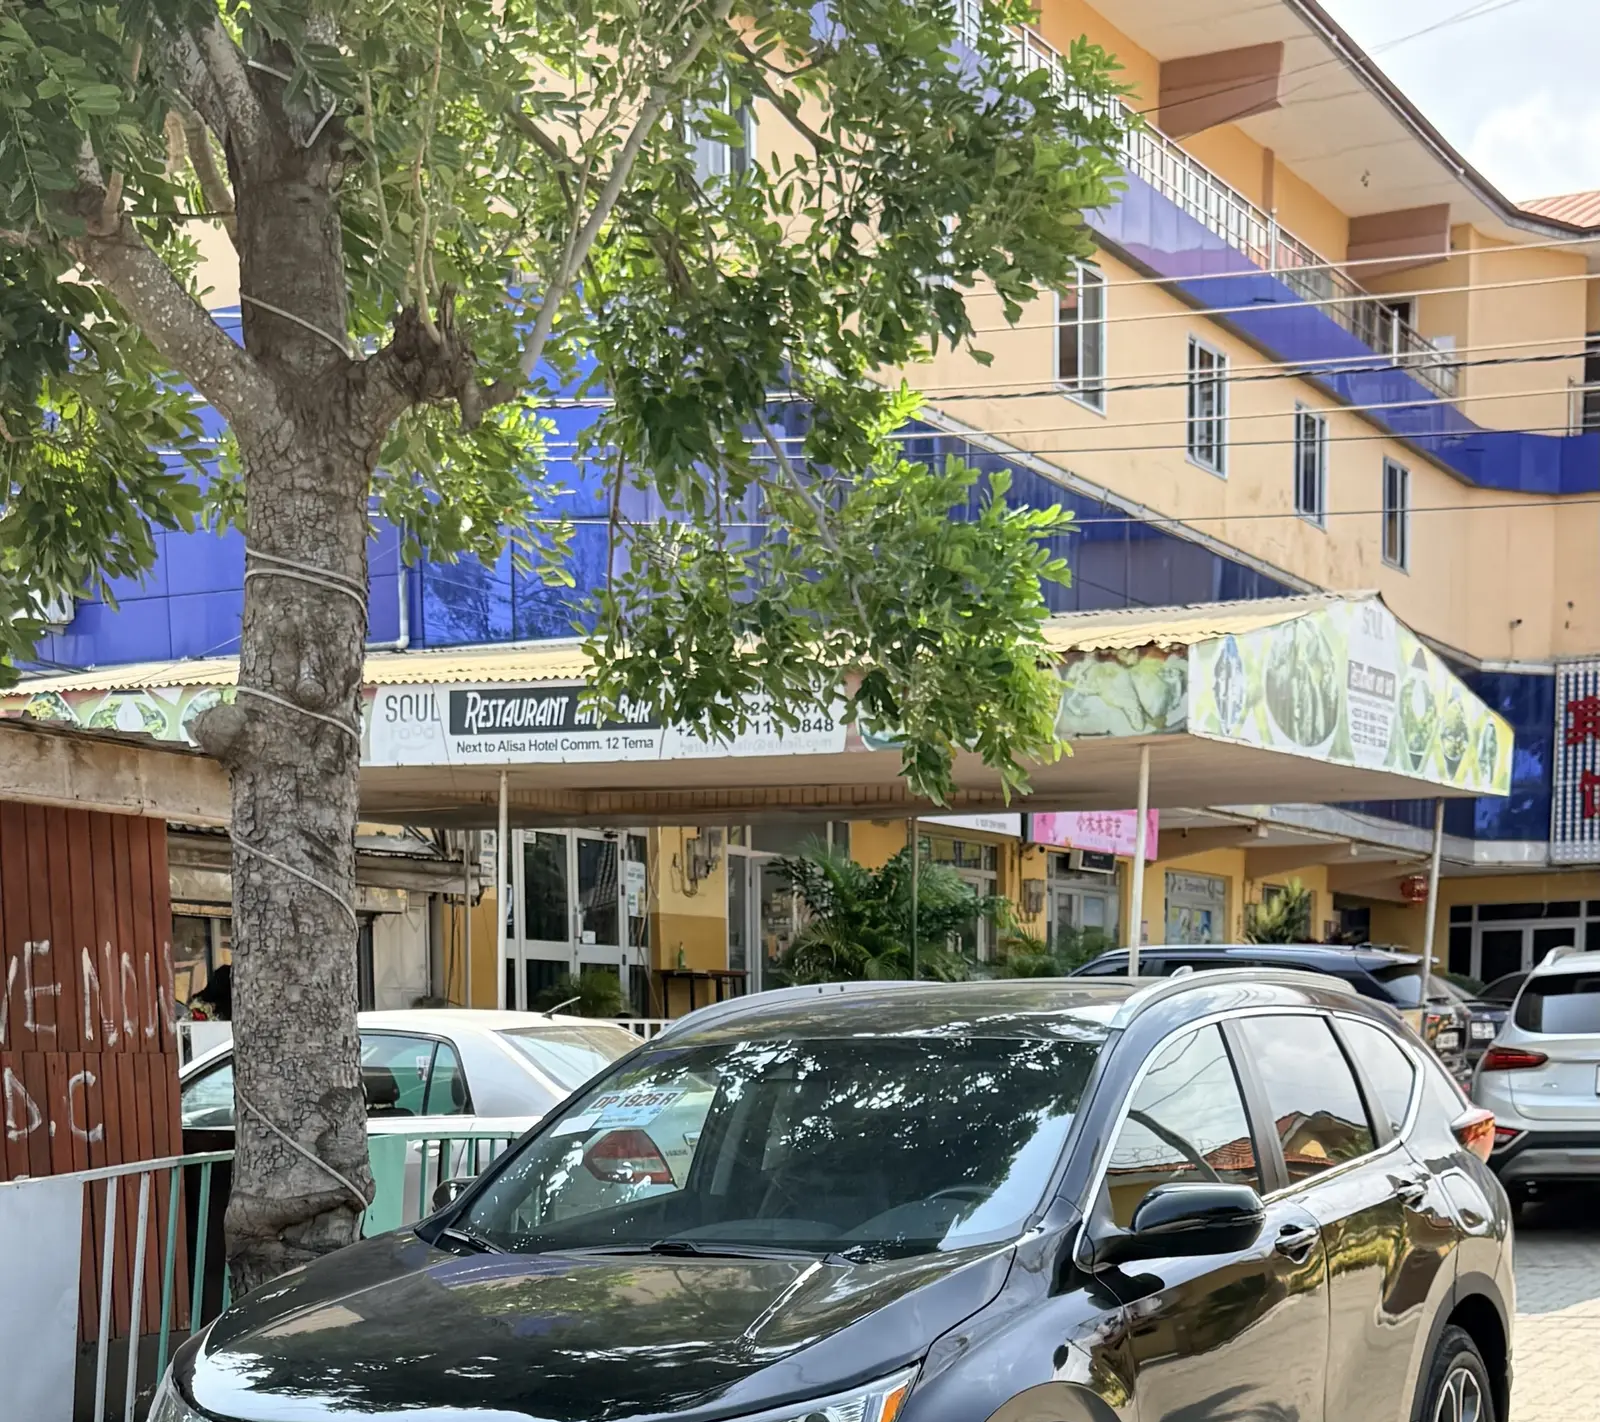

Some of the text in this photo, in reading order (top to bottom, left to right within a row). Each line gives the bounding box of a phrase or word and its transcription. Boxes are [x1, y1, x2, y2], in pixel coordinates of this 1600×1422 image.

[385, 693, 441, 723] SOUL
[456, 737, 654, 754] Next to Alisa Hotel Comm. 12 Tema
[591, 1092, 679, 1110] DP 1926 R
